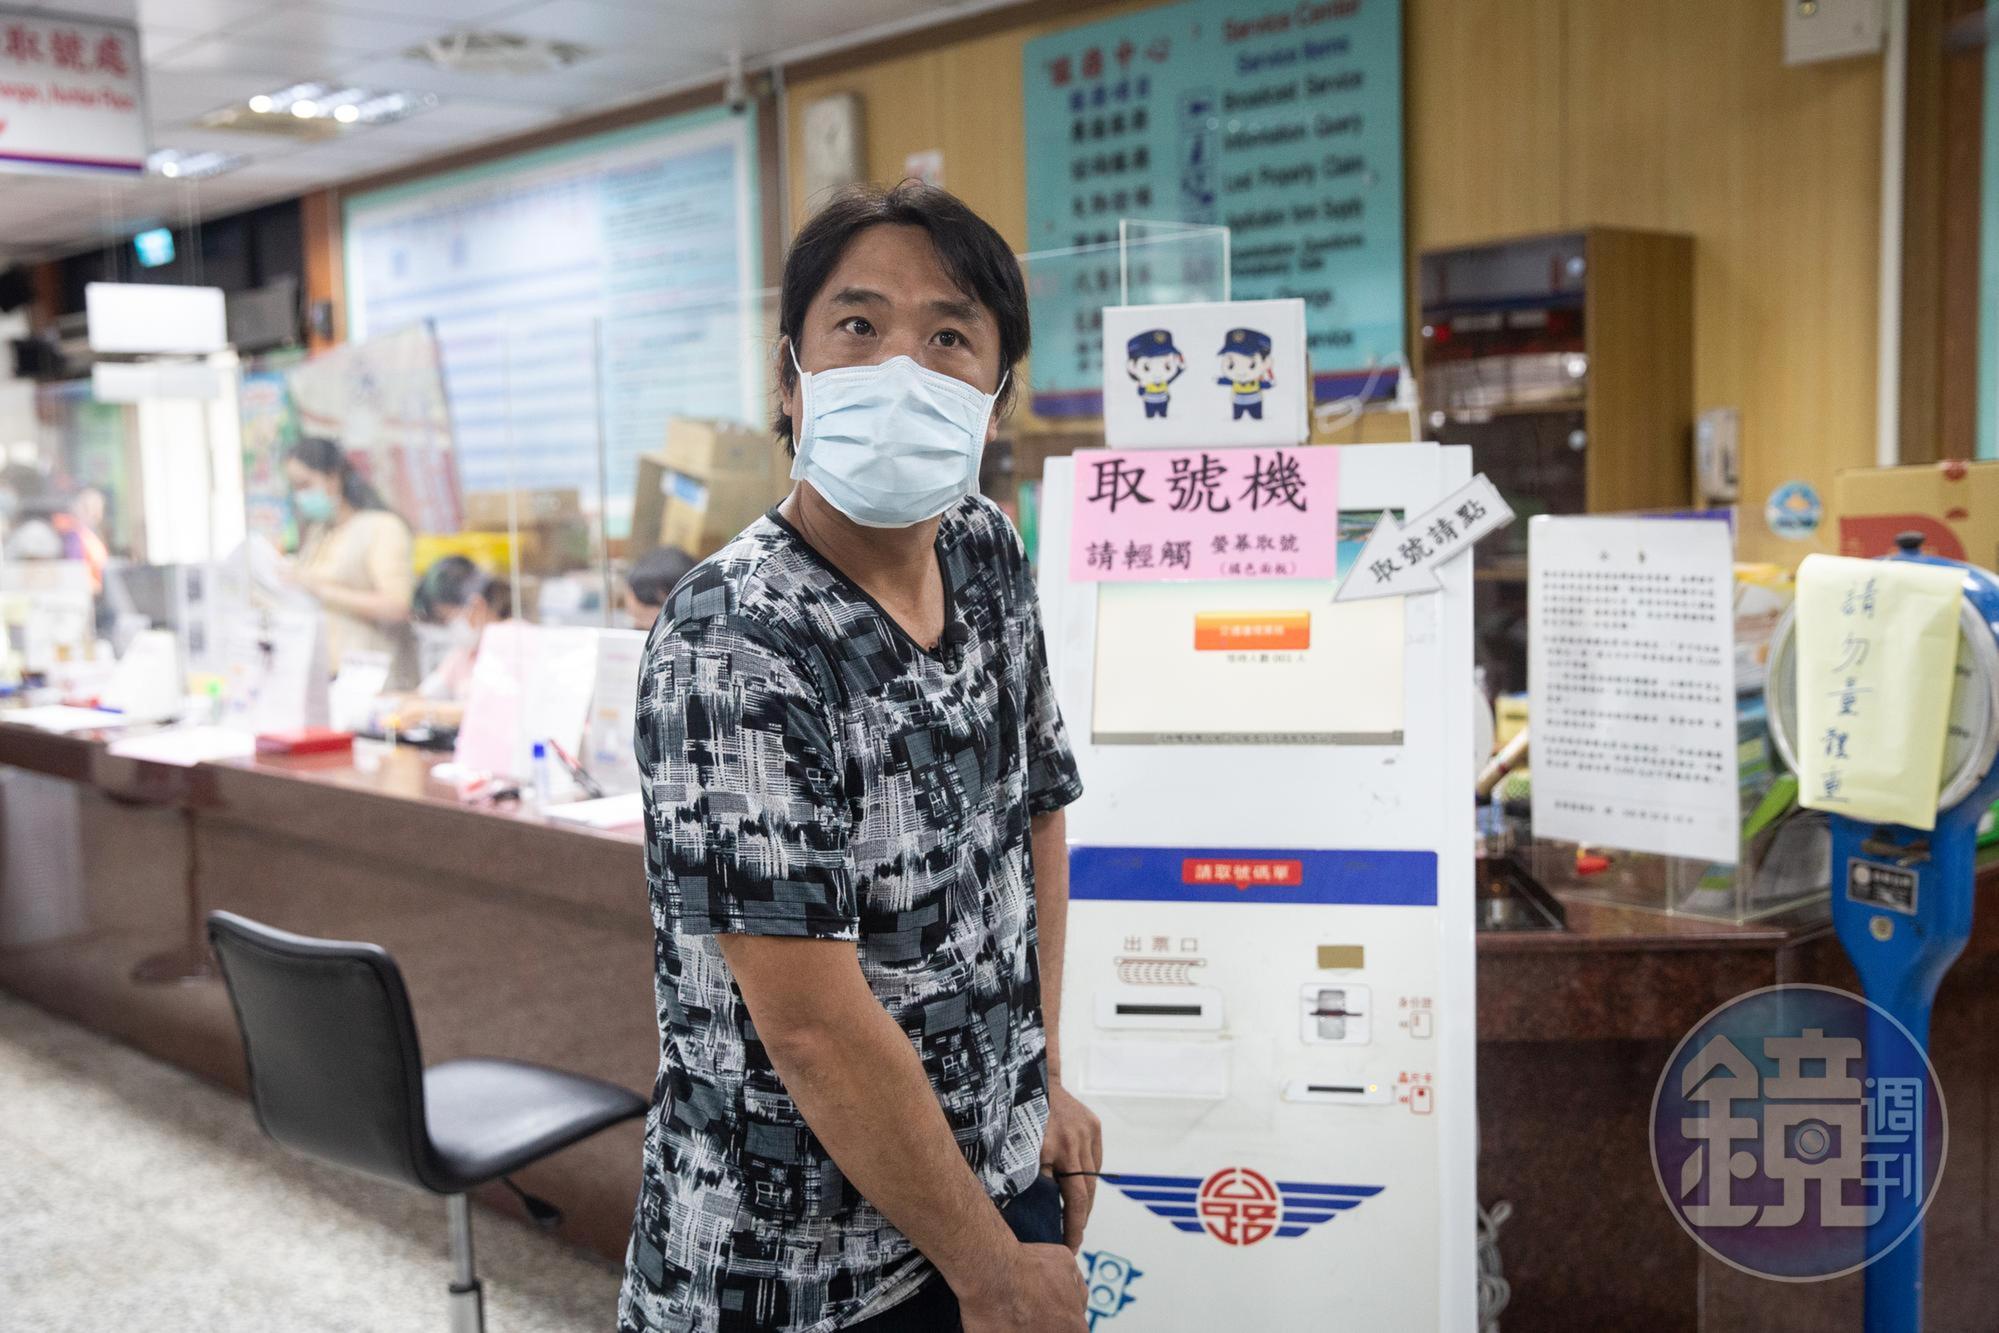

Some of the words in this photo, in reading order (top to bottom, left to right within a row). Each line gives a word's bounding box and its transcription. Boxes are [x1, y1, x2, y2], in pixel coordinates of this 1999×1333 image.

[1088, 450, 1308, 514] 取號機
[1085, 538, 1192, 571] 請輕觸
[1210, 533, 1301, 554] 螢幕取號
[1369, 498, 1487, 584] 取號請點
[1194, 864, 1290, 882] 請取號碼單
[1123, 935, 1199, 952] 出票口
